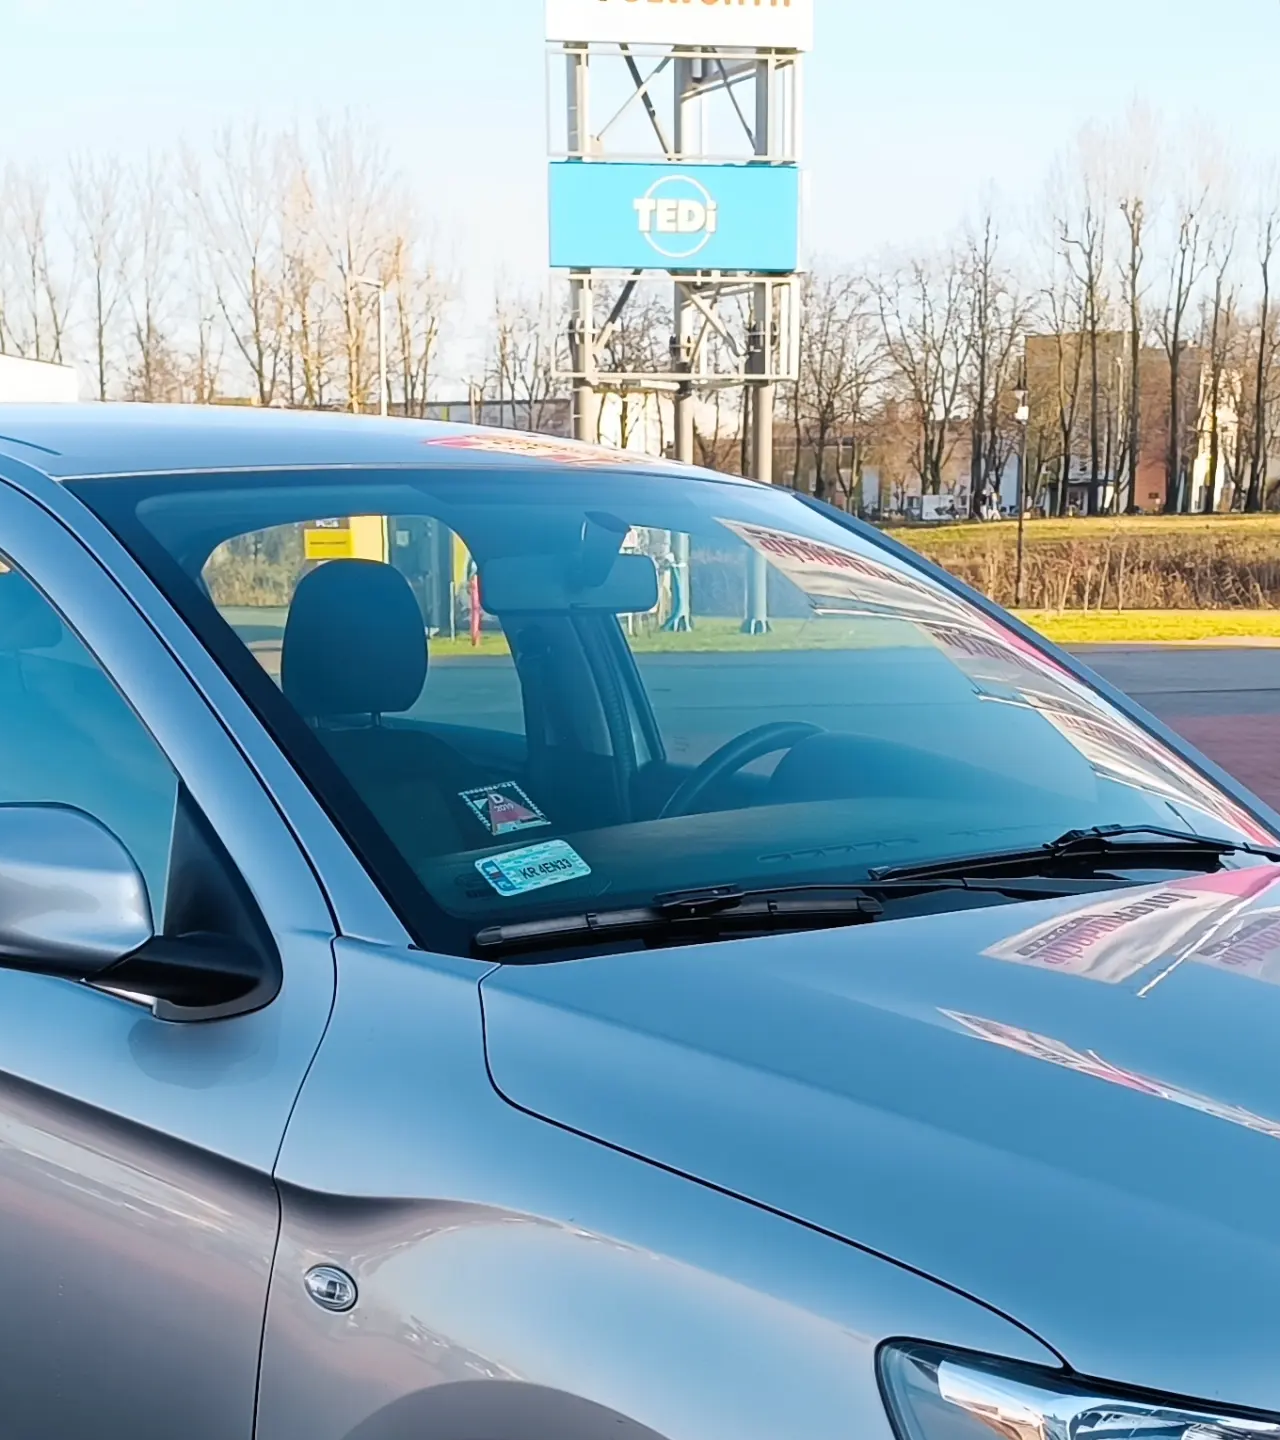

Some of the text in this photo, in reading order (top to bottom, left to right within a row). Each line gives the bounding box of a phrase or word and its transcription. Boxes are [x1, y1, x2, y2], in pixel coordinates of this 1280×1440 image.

[633, 198, 717, 233] TEDi
[519, 858, 573, 880] KR 4EN33
